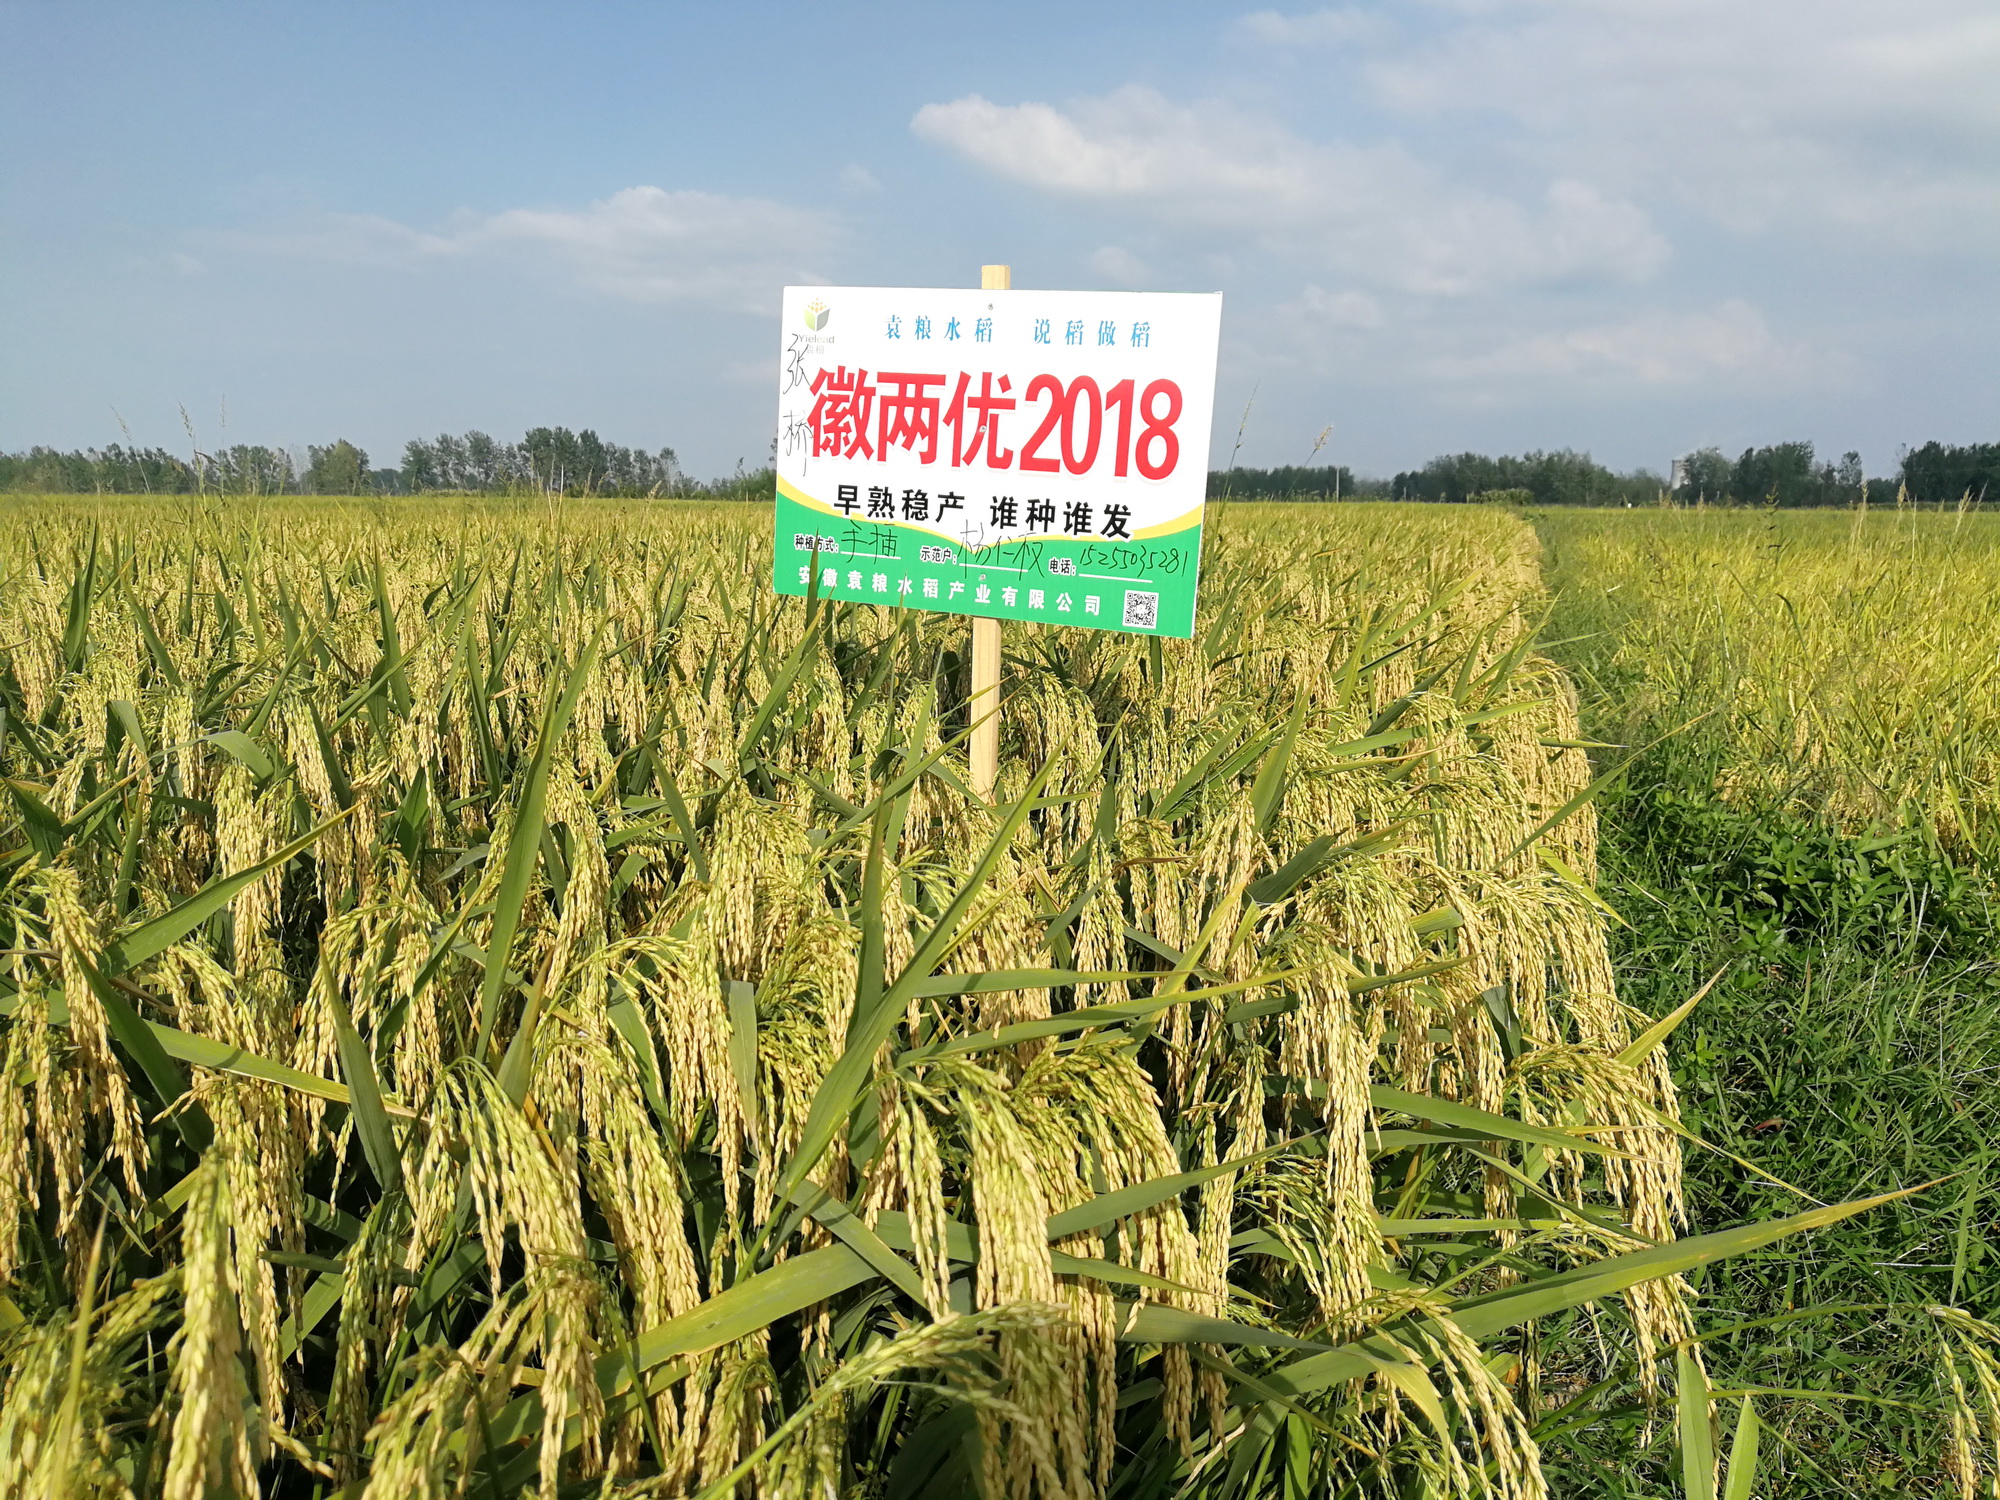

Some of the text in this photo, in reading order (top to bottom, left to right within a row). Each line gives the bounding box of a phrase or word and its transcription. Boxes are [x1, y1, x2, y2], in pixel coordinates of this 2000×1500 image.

[799, 334, 836, 344] Yielead
[884, 314, 1151, 348] 袁粮水稻 说稻做稻
[807, 365, 1183, 481] 徽两优2018
[833, 484, 1132, 539] 早熟稳产 谁种谁发
[920, 546, 958, 565] 示范户：
[1049, 558, 1076, 575] 电话：
[1079, 545, 1188, 577] 15255035281
[798, 565, 1101, 616] 安徽袁粮水稻产业有限公司
